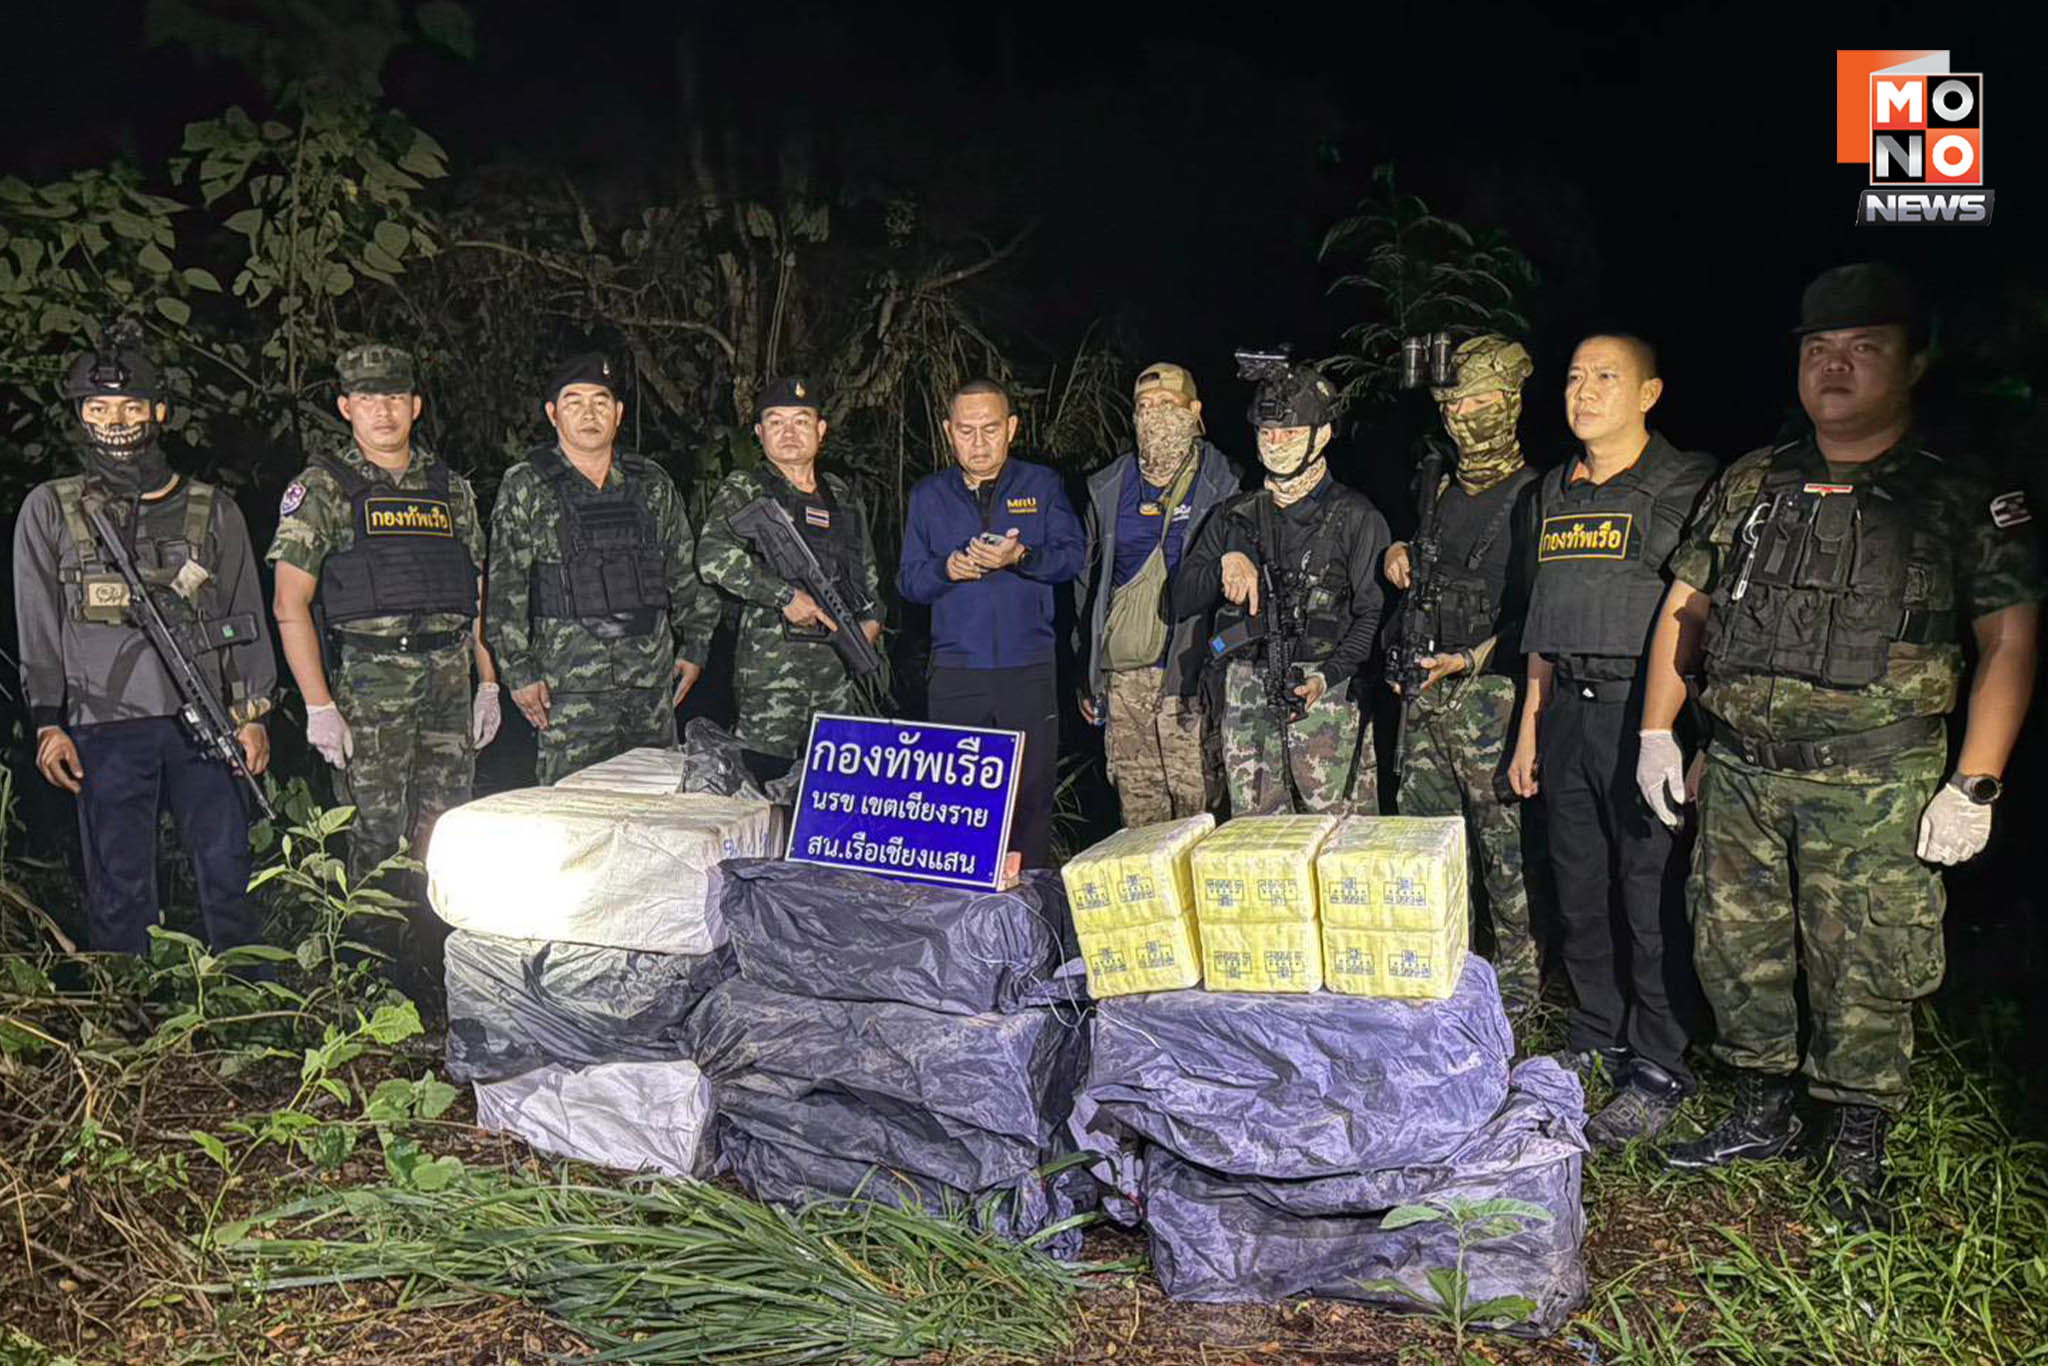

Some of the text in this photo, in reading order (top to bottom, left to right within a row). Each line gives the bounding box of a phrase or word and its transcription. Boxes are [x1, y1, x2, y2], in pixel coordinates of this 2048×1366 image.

[371, 504, 449, 529] กองทัพเรือ
[1543, 520, 1622, 551] กองทัพเรือ
[811, 731, 1005, 790] กองทัพเรือ
[811, 789, 989, 828] นรข เขตเชียงราย
[806, 831, 976, 875] สน.เรือเชียงแสน
